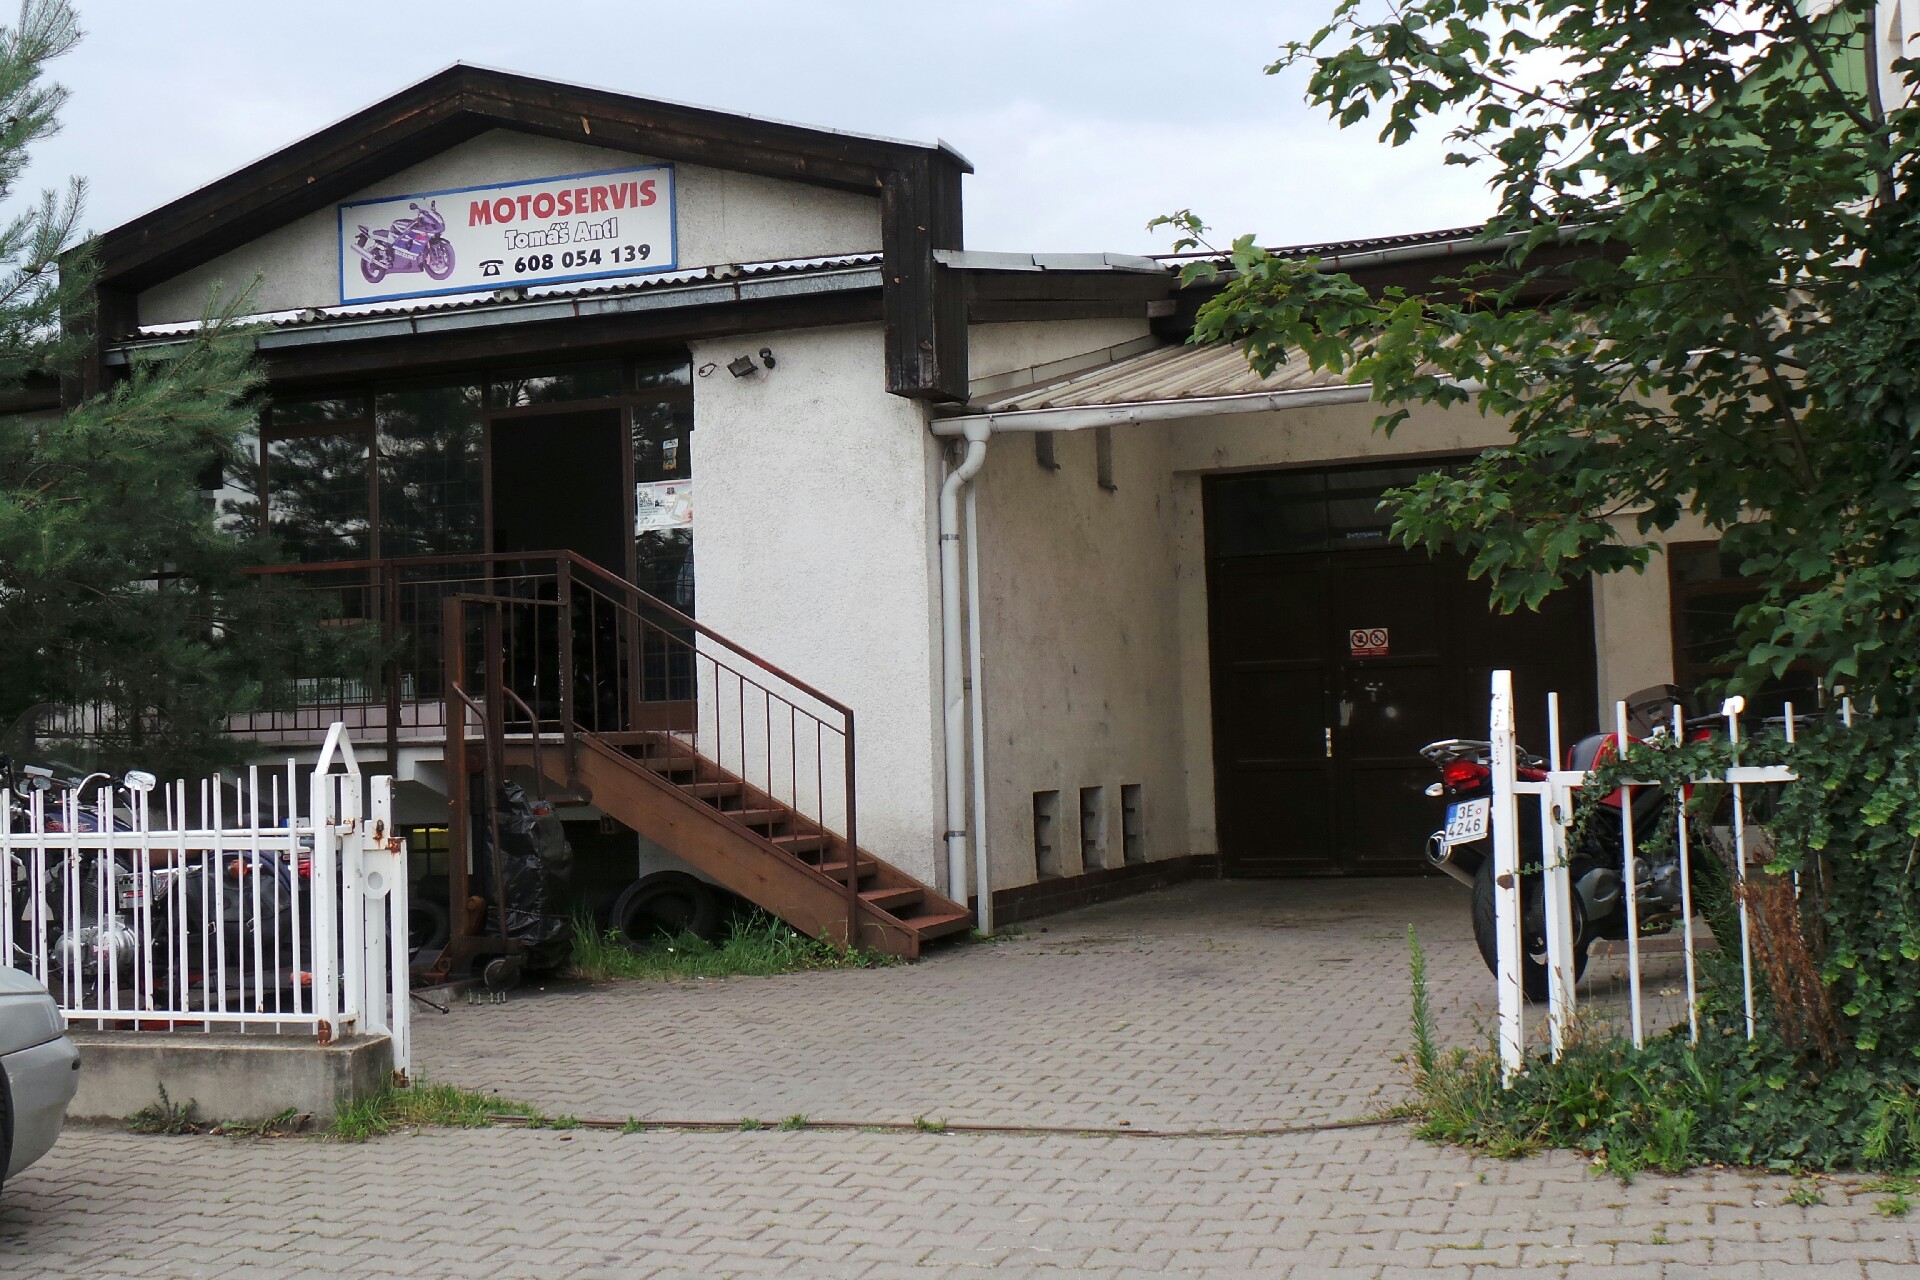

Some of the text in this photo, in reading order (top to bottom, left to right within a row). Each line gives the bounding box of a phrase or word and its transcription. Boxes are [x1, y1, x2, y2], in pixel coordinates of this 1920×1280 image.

[468, 179, 657, 227] MOTOSERVIS
[505, 216, 619, 250] Tomáš Antl
[514, 243, 651, 274] 608 054 139
[1458, 803, 1475, 819] 3E
[1448, 818, 1481, 837] 4246
